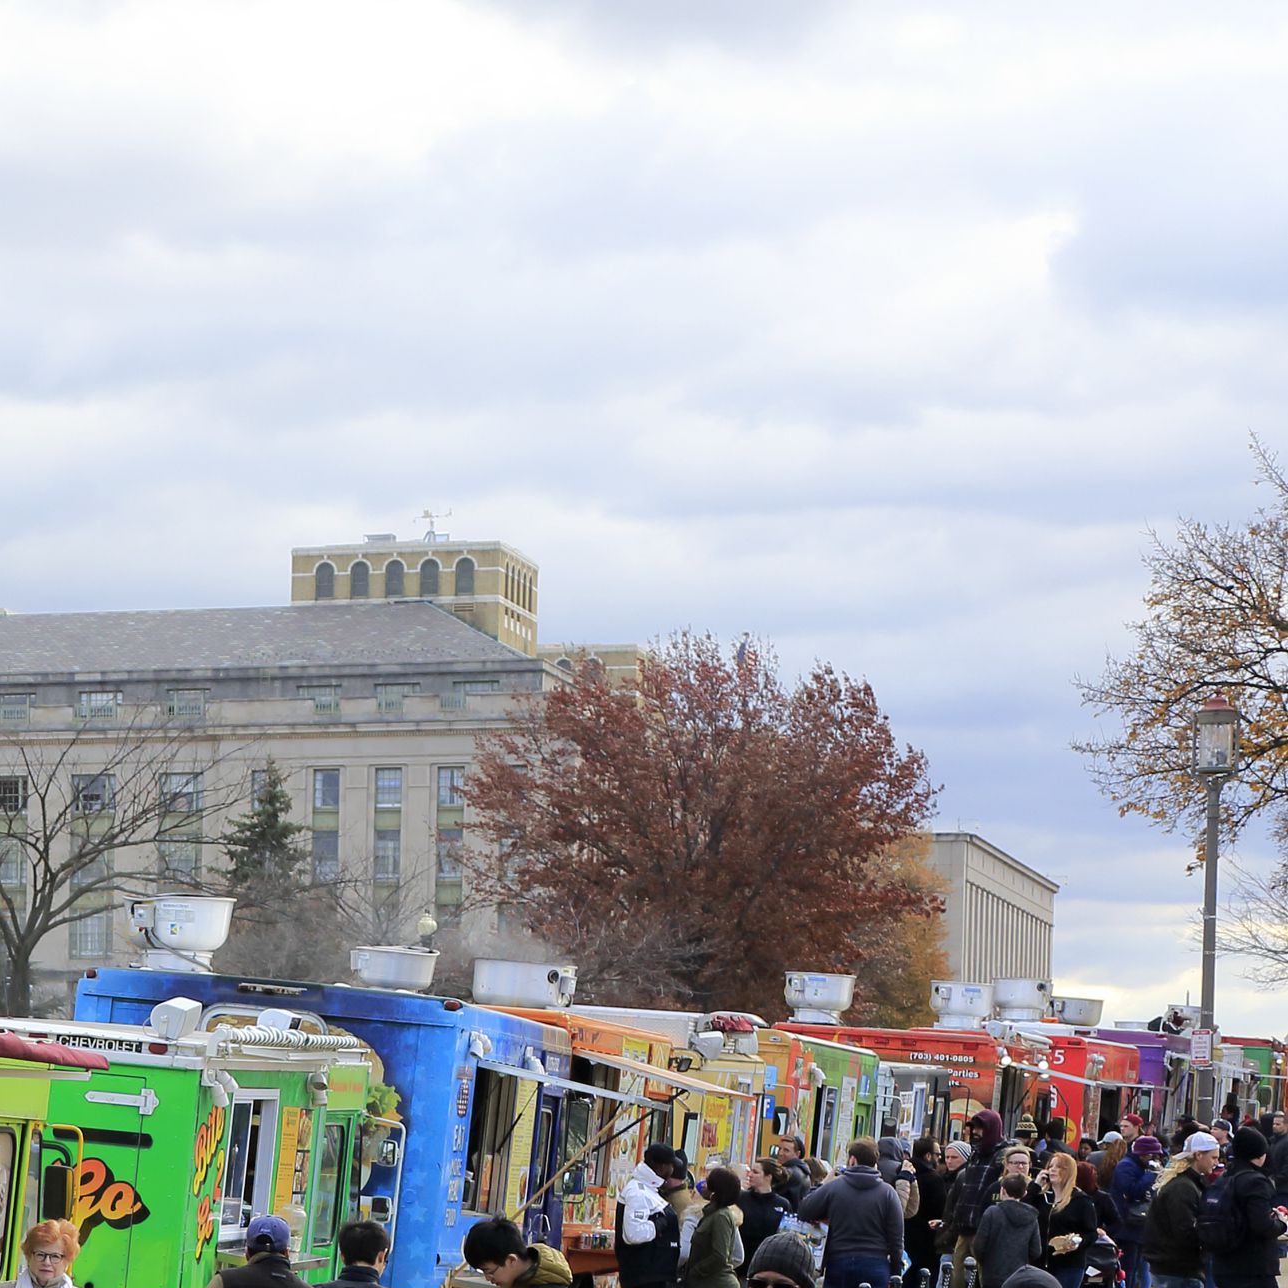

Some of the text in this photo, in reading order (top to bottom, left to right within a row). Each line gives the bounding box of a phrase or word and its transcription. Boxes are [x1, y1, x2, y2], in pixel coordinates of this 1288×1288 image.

[58, 1035, 140, 1053] CHEVROLET
[910, 1051, 975, 1063] (703) 401-0805
[947, 1068, 979, 1078] Parties
[193, 1103, 226, 1196] Bite
[212, 1148, 225, 1203] 2
